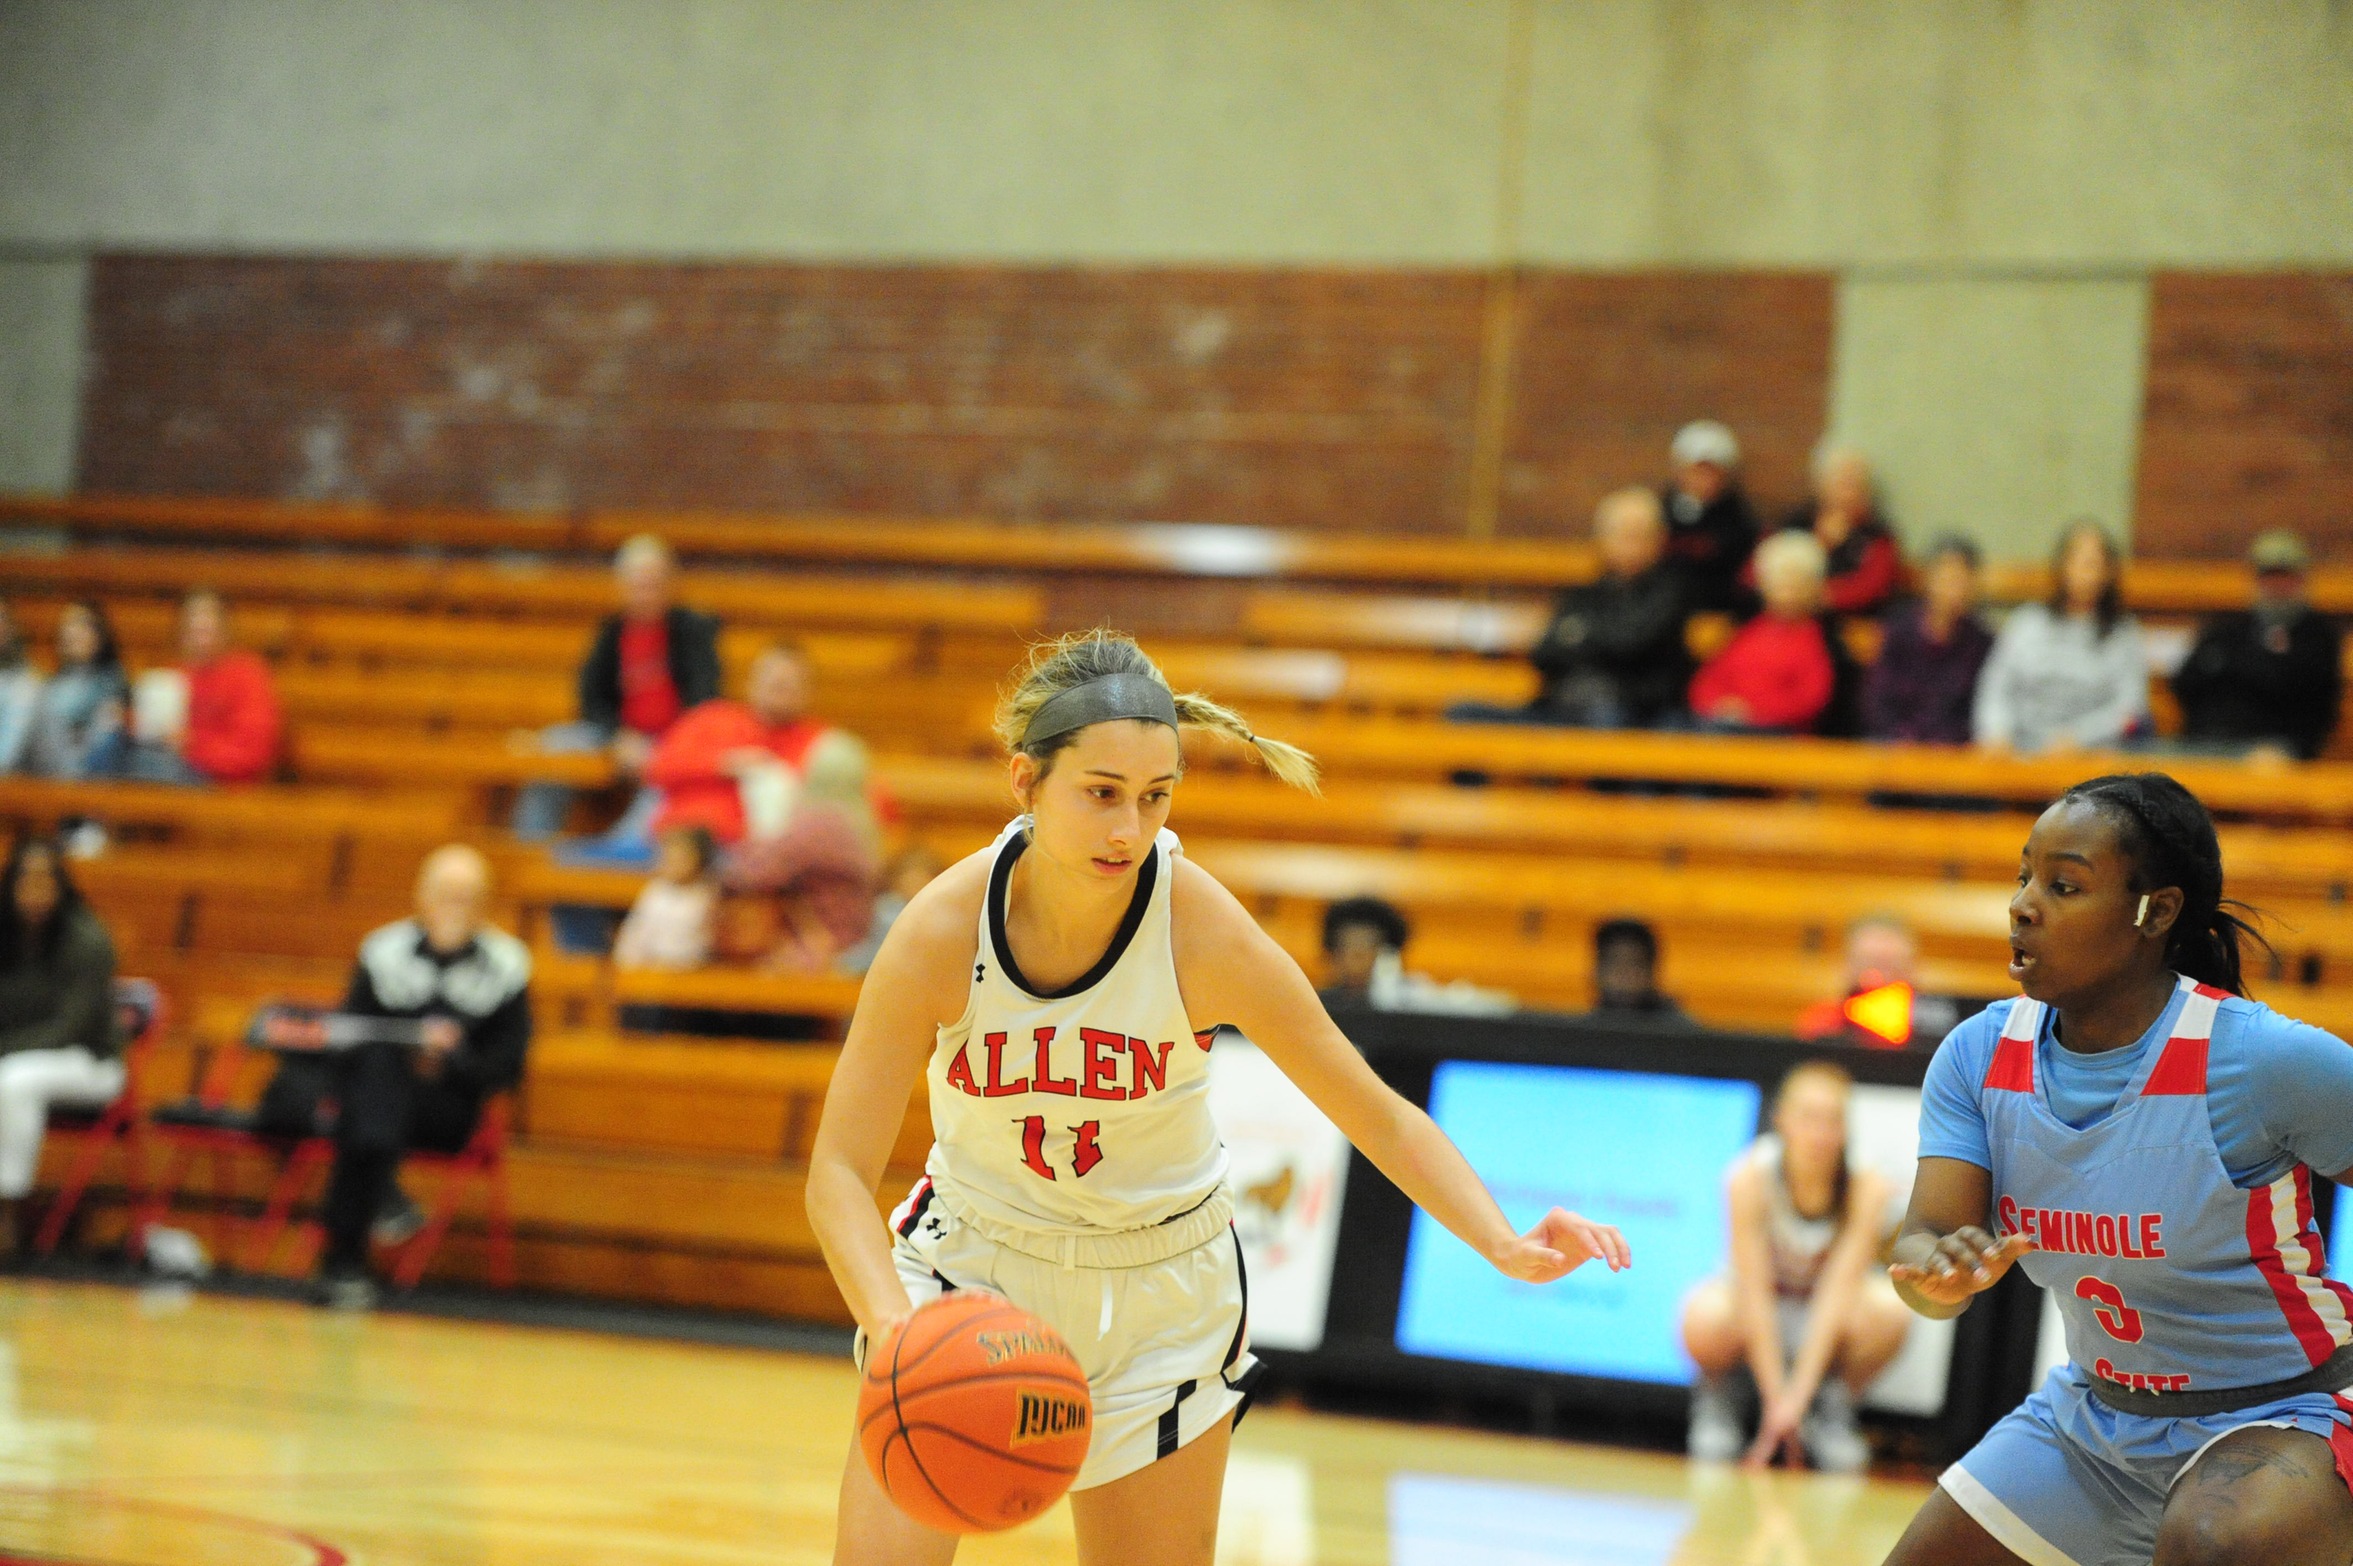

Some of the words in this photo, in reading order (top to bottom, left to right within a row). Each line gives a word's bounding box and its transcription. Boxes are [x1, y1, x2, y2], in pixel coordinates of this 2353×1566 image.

[947, 1026, 1175, 1100] ALLEN
[1011, 1115, 1103, 1181] 11
[1998, 1195, 2167, 1259] SEMINOLE
[2074, 1276, 2144, 1343] 3
